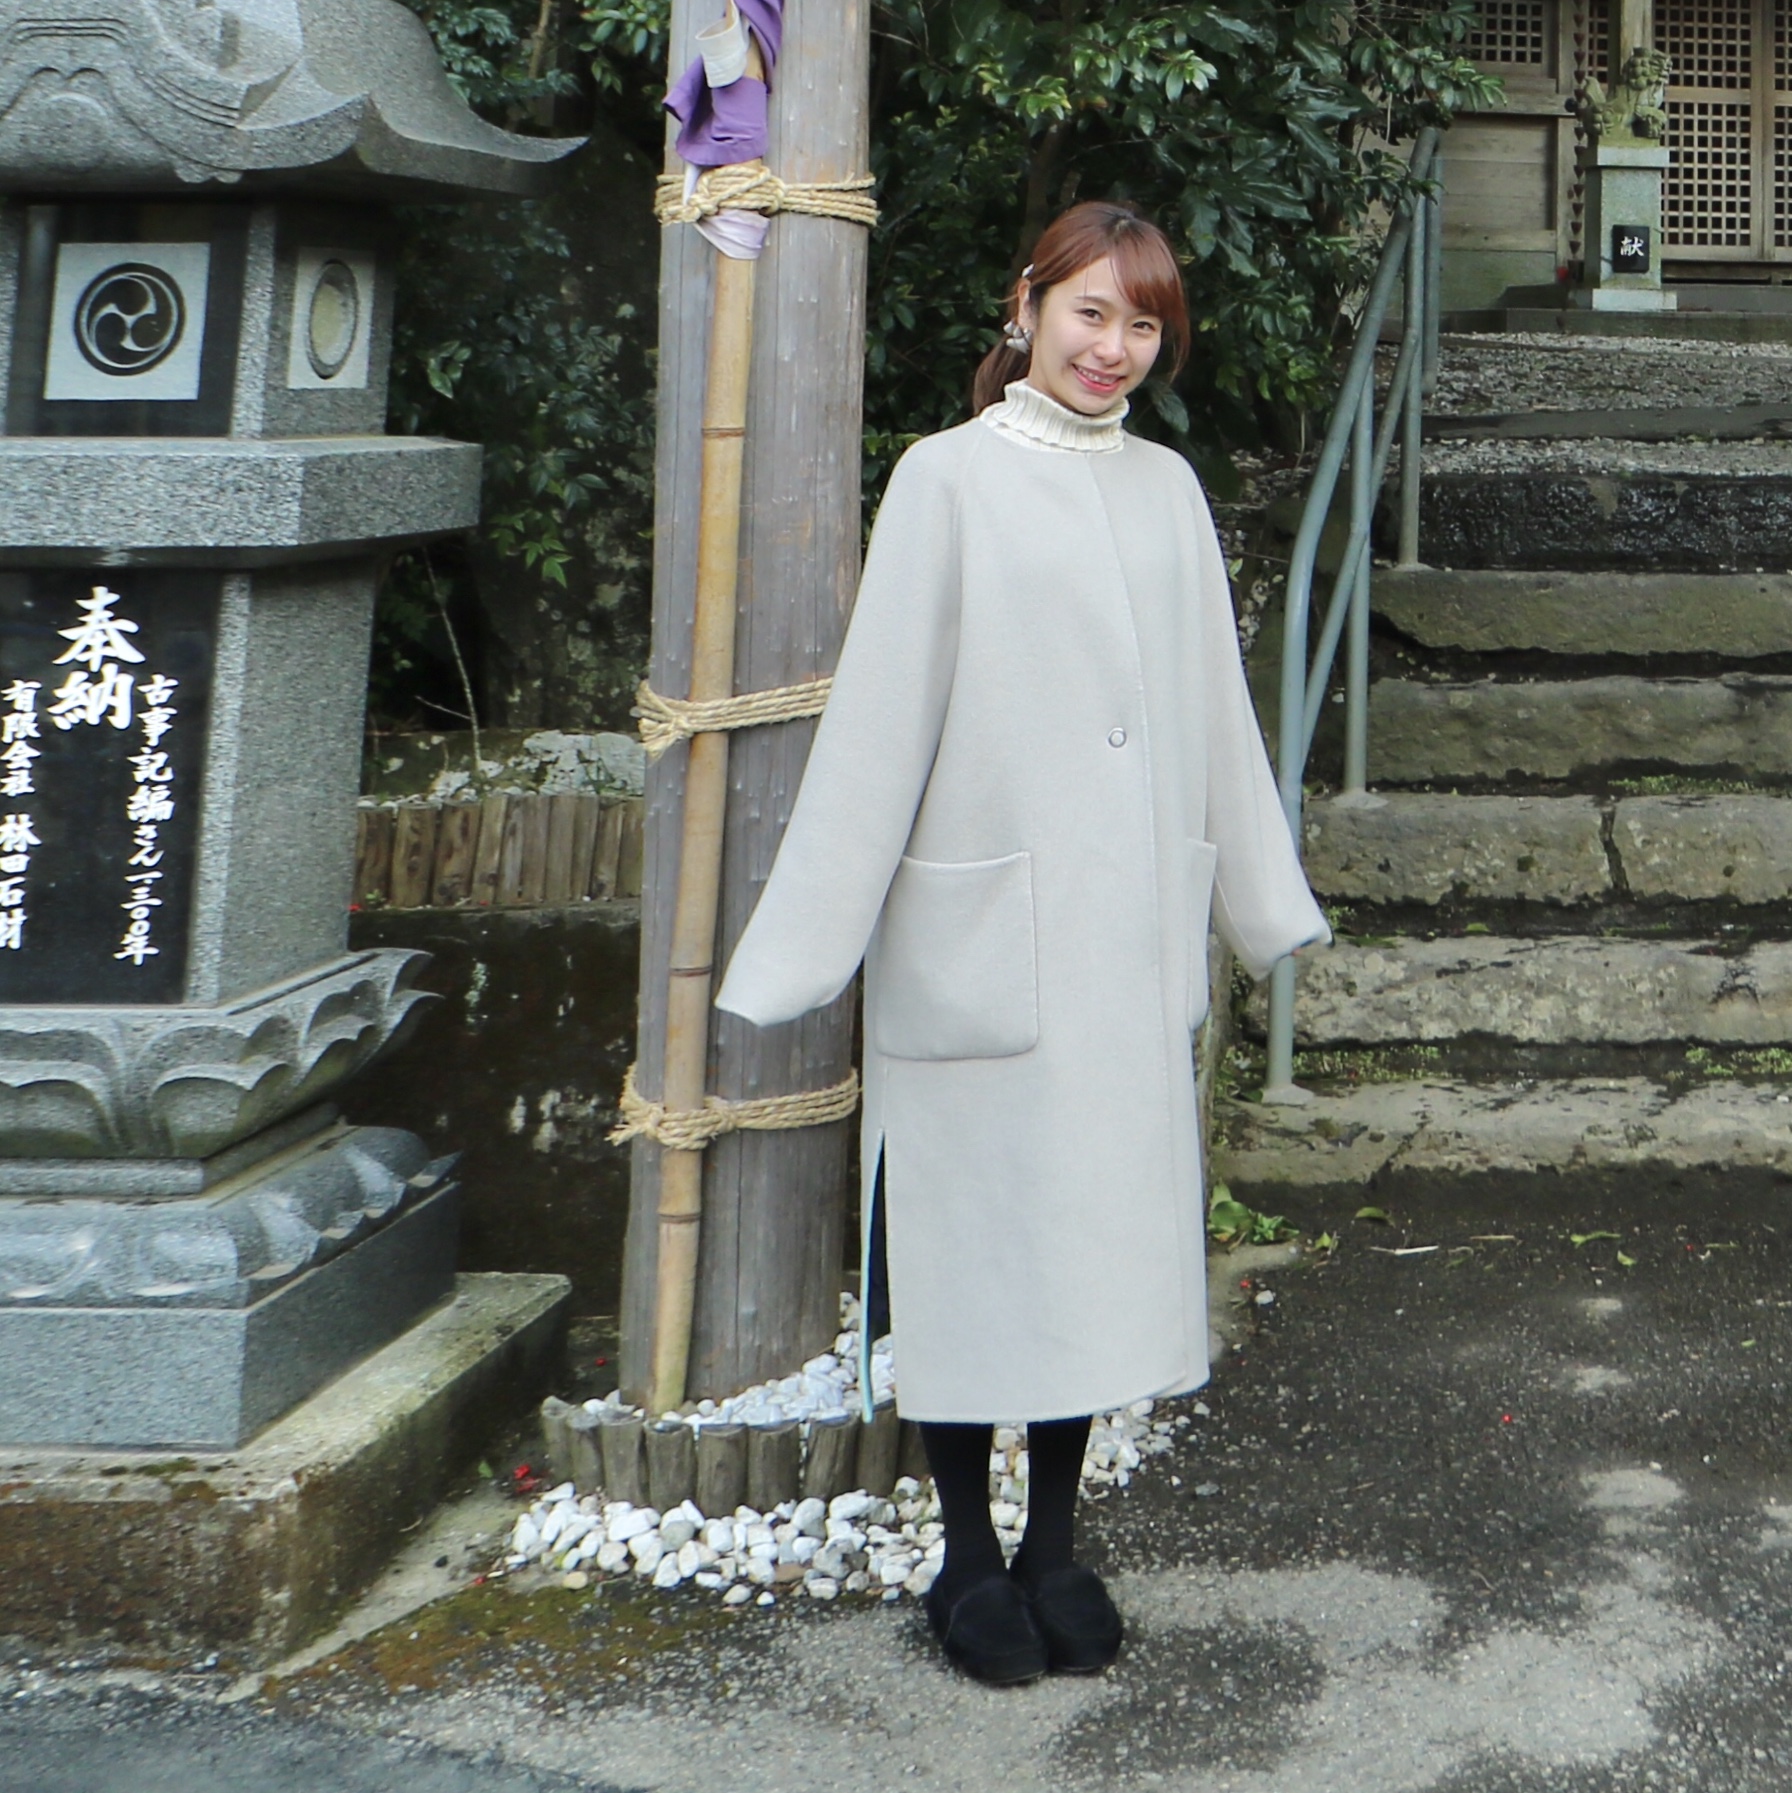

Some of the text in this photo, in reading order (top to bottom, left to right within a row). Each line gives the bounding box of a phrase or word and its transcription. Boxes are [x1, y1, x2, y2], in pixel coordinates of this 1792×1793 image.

[1620, 235, 1645, 257] 献
[47, 585, 146, 731] 奉納
[0, 679, 42, 798] 有限会社
